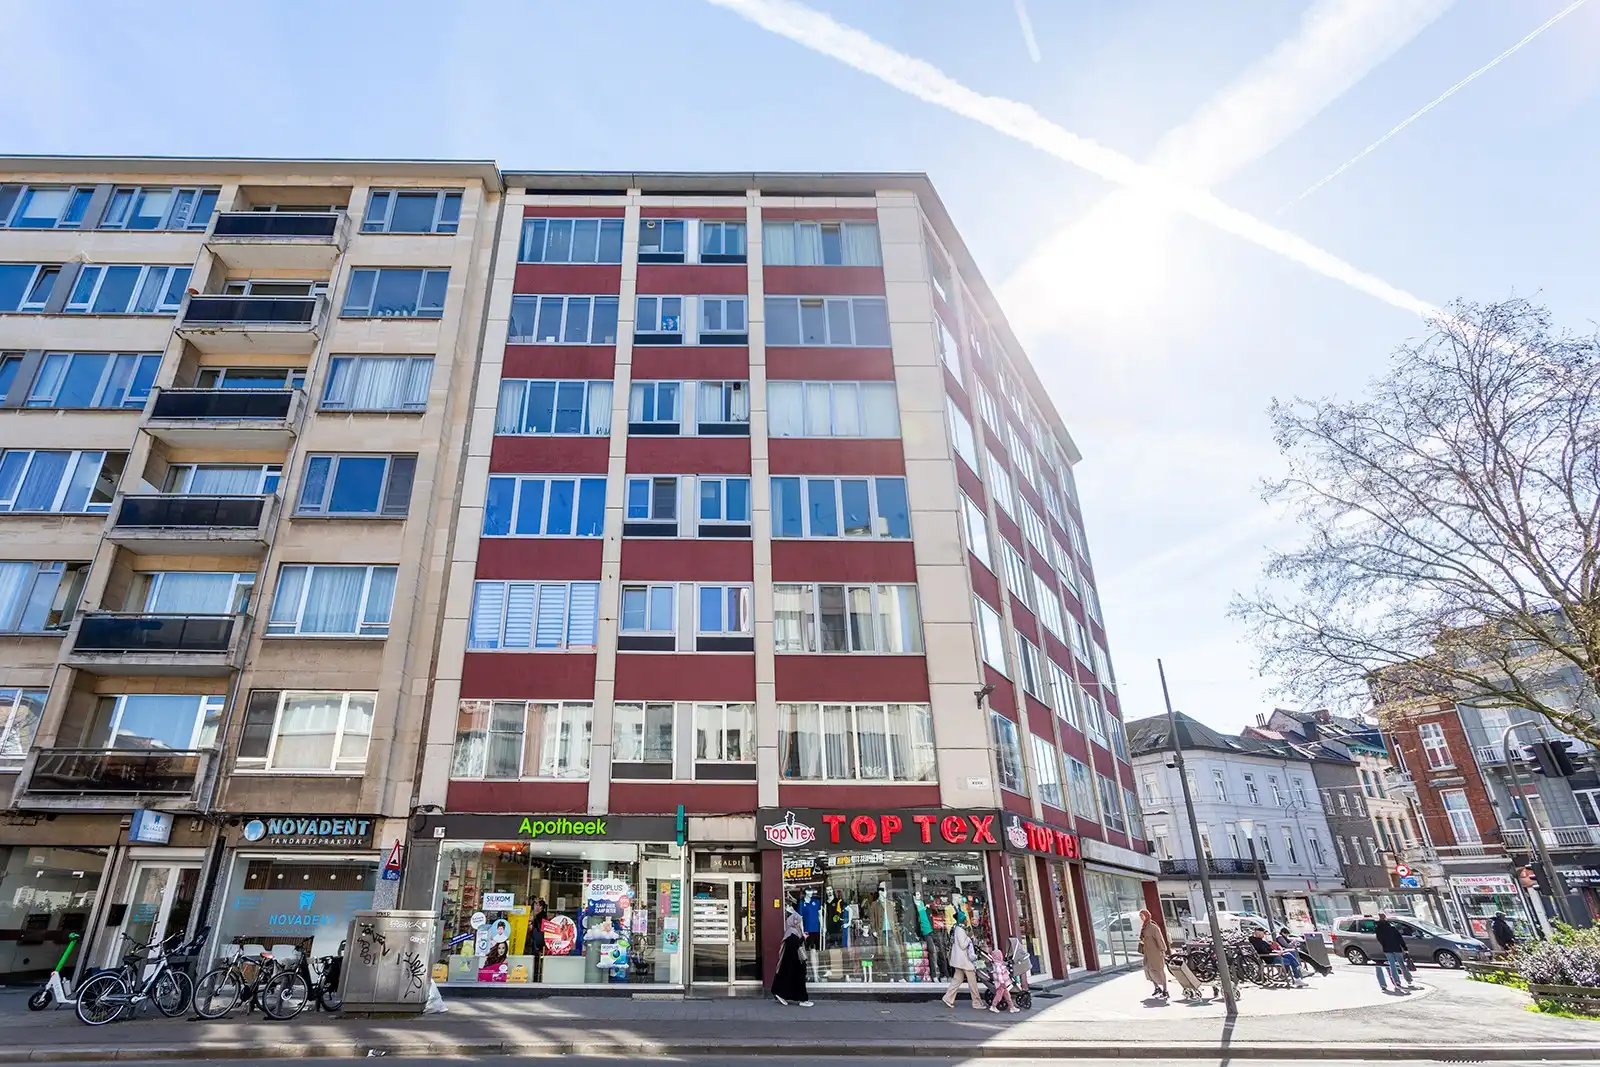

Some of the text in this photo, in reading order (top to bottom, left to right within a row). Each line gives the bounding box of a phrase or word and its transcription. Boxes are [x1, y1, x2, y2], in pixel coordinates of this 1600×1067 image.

[267, 818, 370, 836] NOVADENT
[518, 817, 607, 837] Apotheek
[764, 826, 816, 841] Top Tex
[822, 815, 902, 843] TOP
[1023, 822, 1053, 853] TOP
[269, 915, 336, 926] NOVADENT
